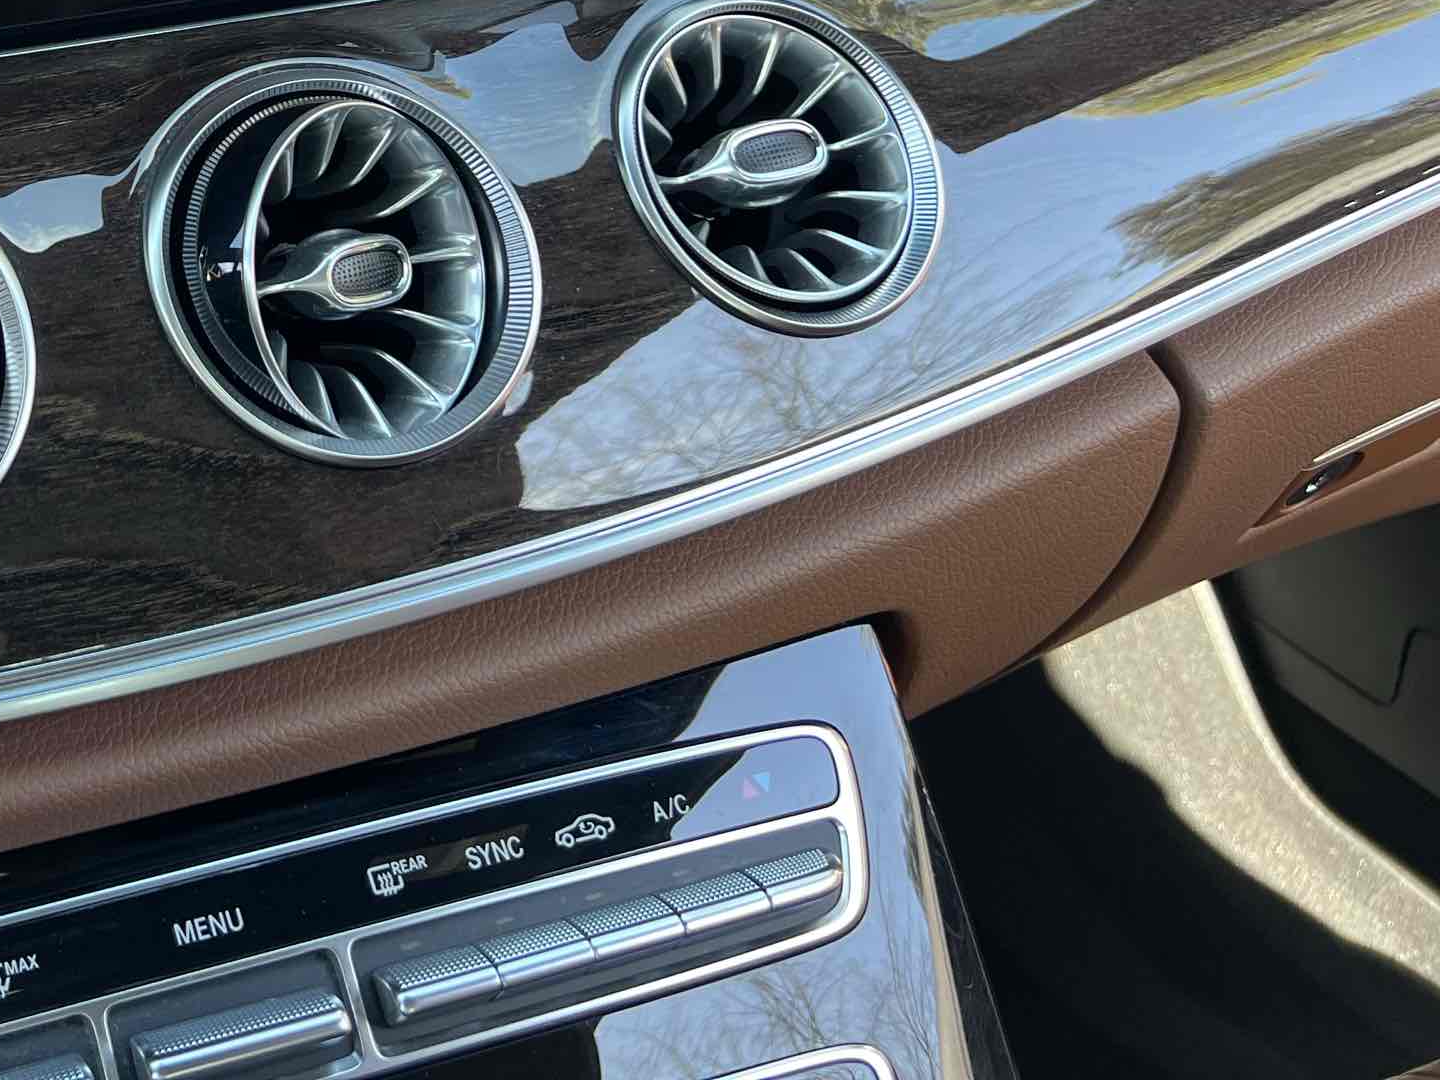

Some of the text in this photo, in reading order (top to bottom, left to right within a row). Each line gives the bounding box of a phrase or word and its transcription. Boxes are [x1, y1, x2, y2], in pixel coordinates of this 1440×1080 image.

[653, 793, 690, 823] A/C
[391, 853, 428, 876] REAR
[464, 835, 525, 871] SYNC
[173, 907, 245, 947] MENU
[4, 954, 40, 977] MAX
